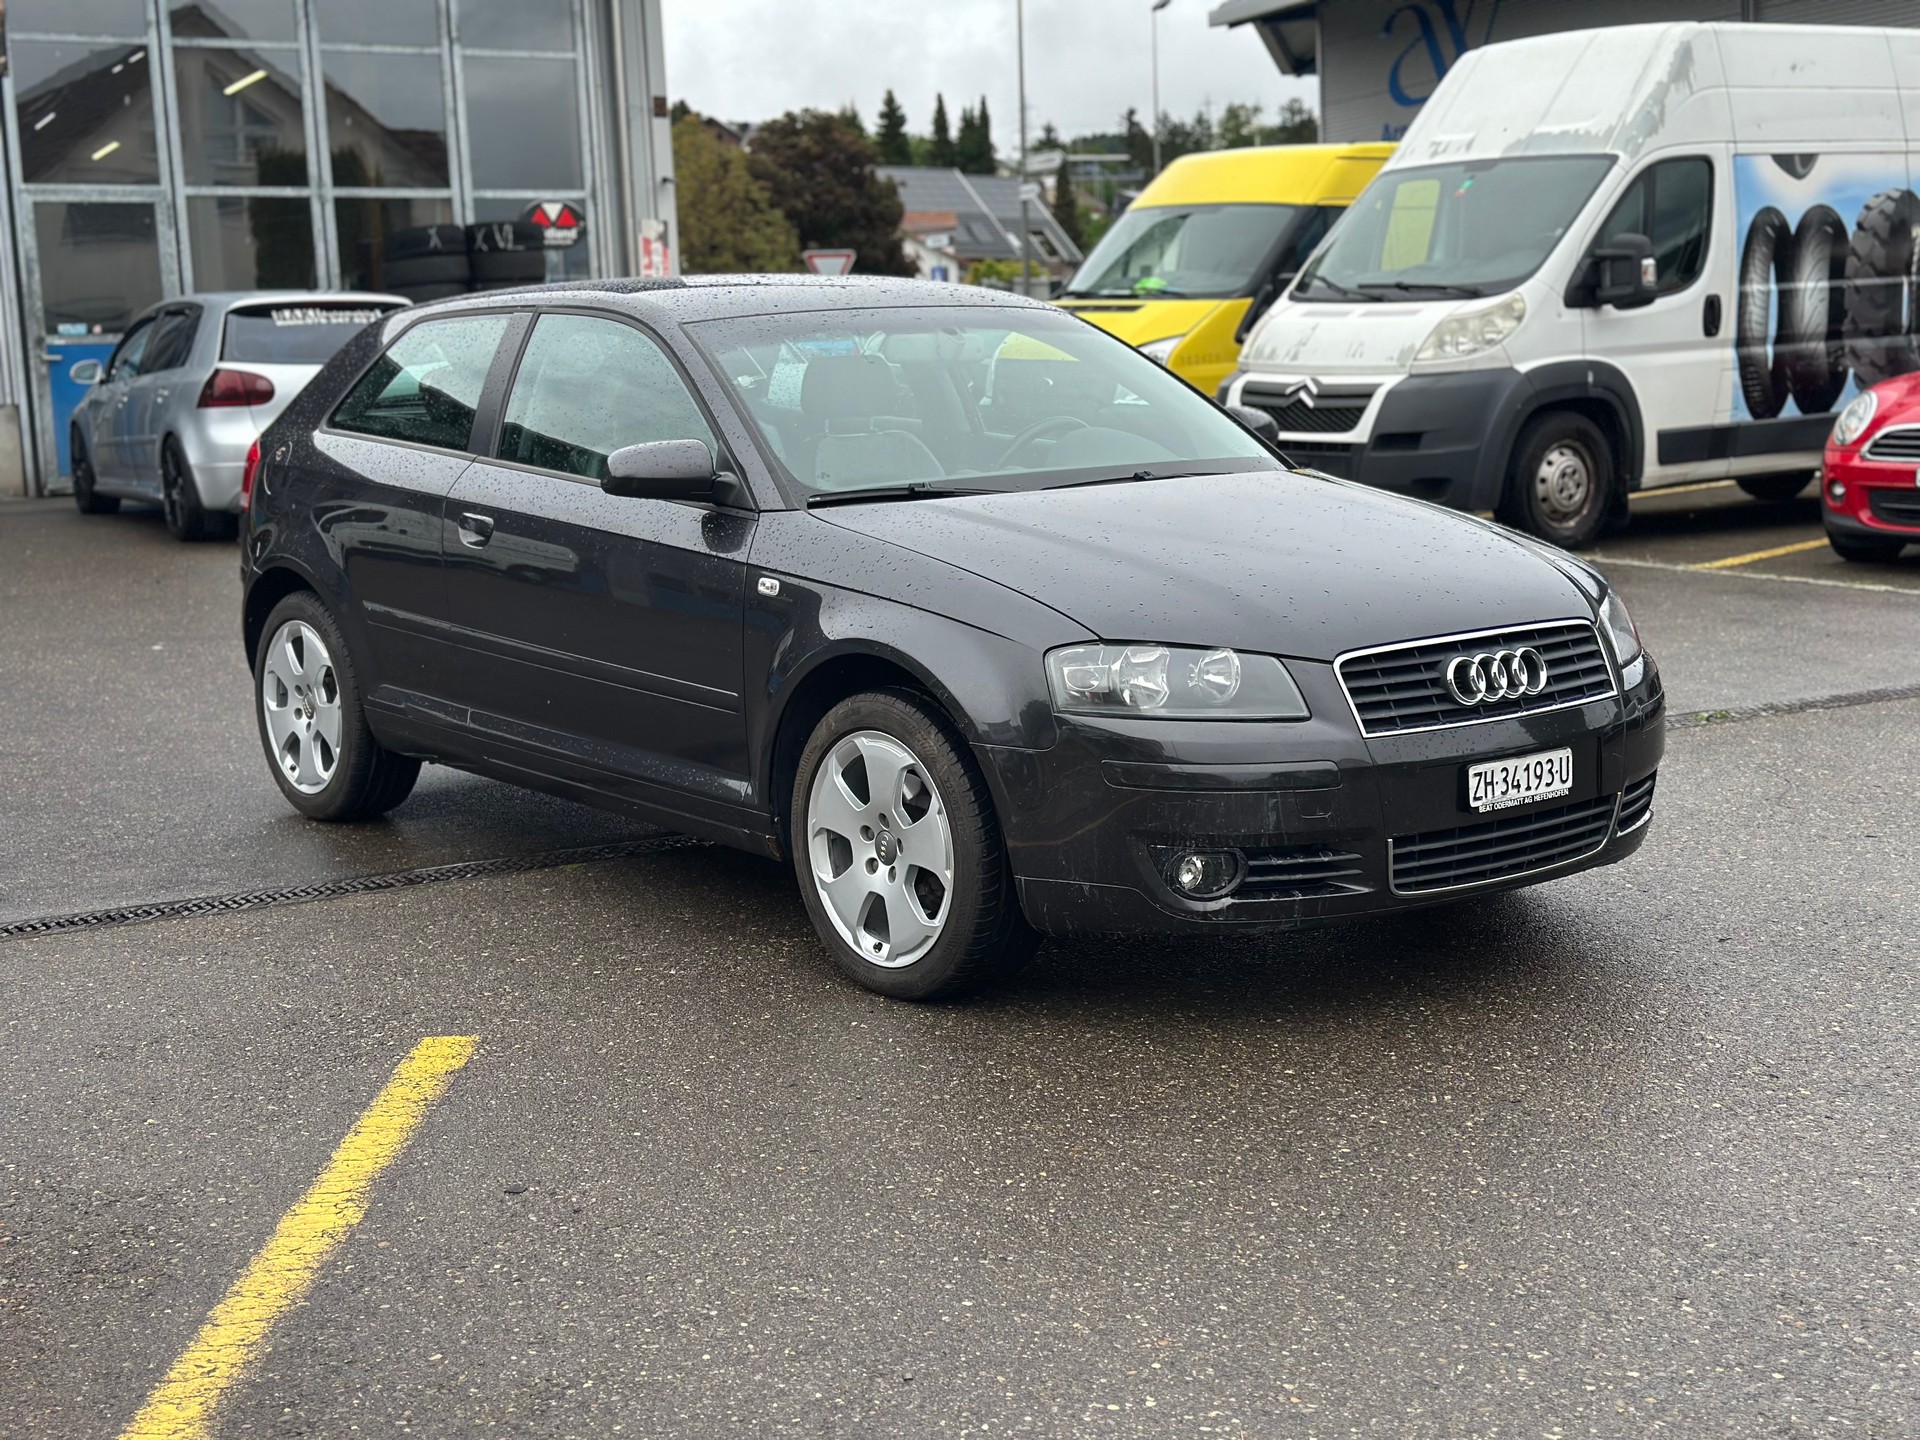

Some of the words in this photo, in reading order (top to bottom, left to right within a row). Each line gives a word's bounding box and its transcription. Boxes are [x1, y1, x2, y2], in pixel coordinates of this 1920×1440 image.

[1479, 803, 1493, 813] BEAT
[1493, 797, 1524, 810] ODERMATT
[1534, 788, 1569, 802] HEFENHOFEN
